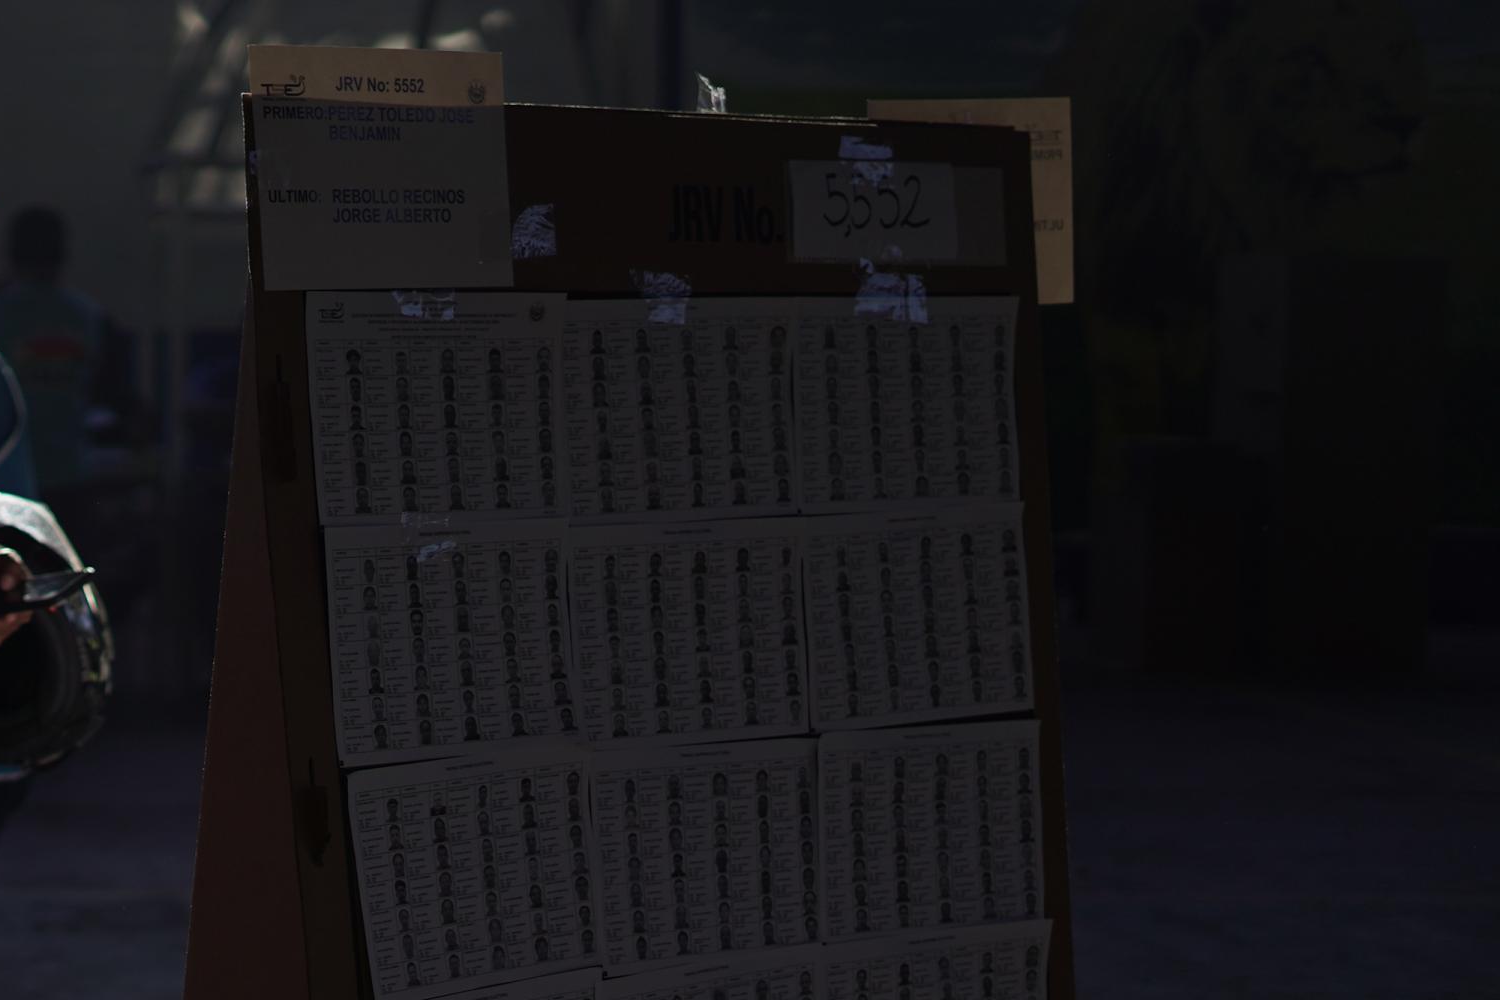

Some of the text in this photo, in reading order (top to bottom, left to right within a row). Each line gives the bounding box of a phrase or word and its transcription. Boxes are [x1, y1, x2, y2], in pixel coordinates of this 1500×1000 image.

[335, 76, 425, 93] JRV No: 5552
[262, 106, 475, 125] PRIMERO: PEREZ TOLEDO JOSE
[328, 125, 402, 142] BENJAMIN
[267, 188, 466, 205] ULTIMO: REBOLLO RECINOS
[332, 207, 452, 224] JORGE ALBERTO
[667, 183, 785, 244] JRV No.
